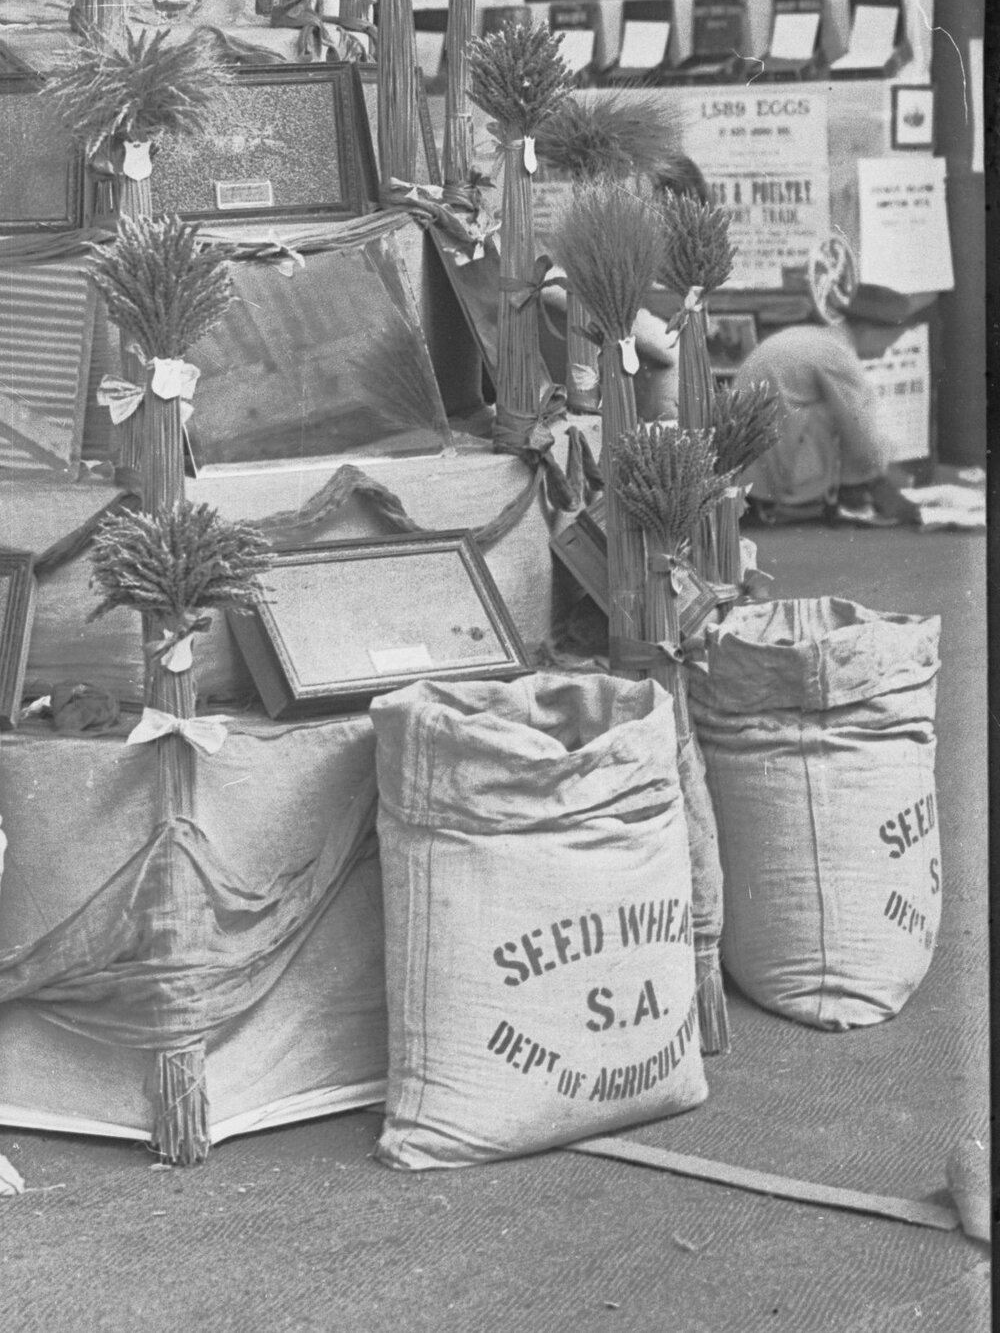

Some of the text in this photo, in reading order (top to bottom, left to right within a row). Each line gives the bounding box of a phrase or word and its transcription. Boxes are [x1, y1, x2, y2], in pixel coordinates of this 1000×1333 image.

[879, 792, 935, 859] SEED
[492, 912, 604, 987] SEED
[556, 1068, 587, 1100] OF
